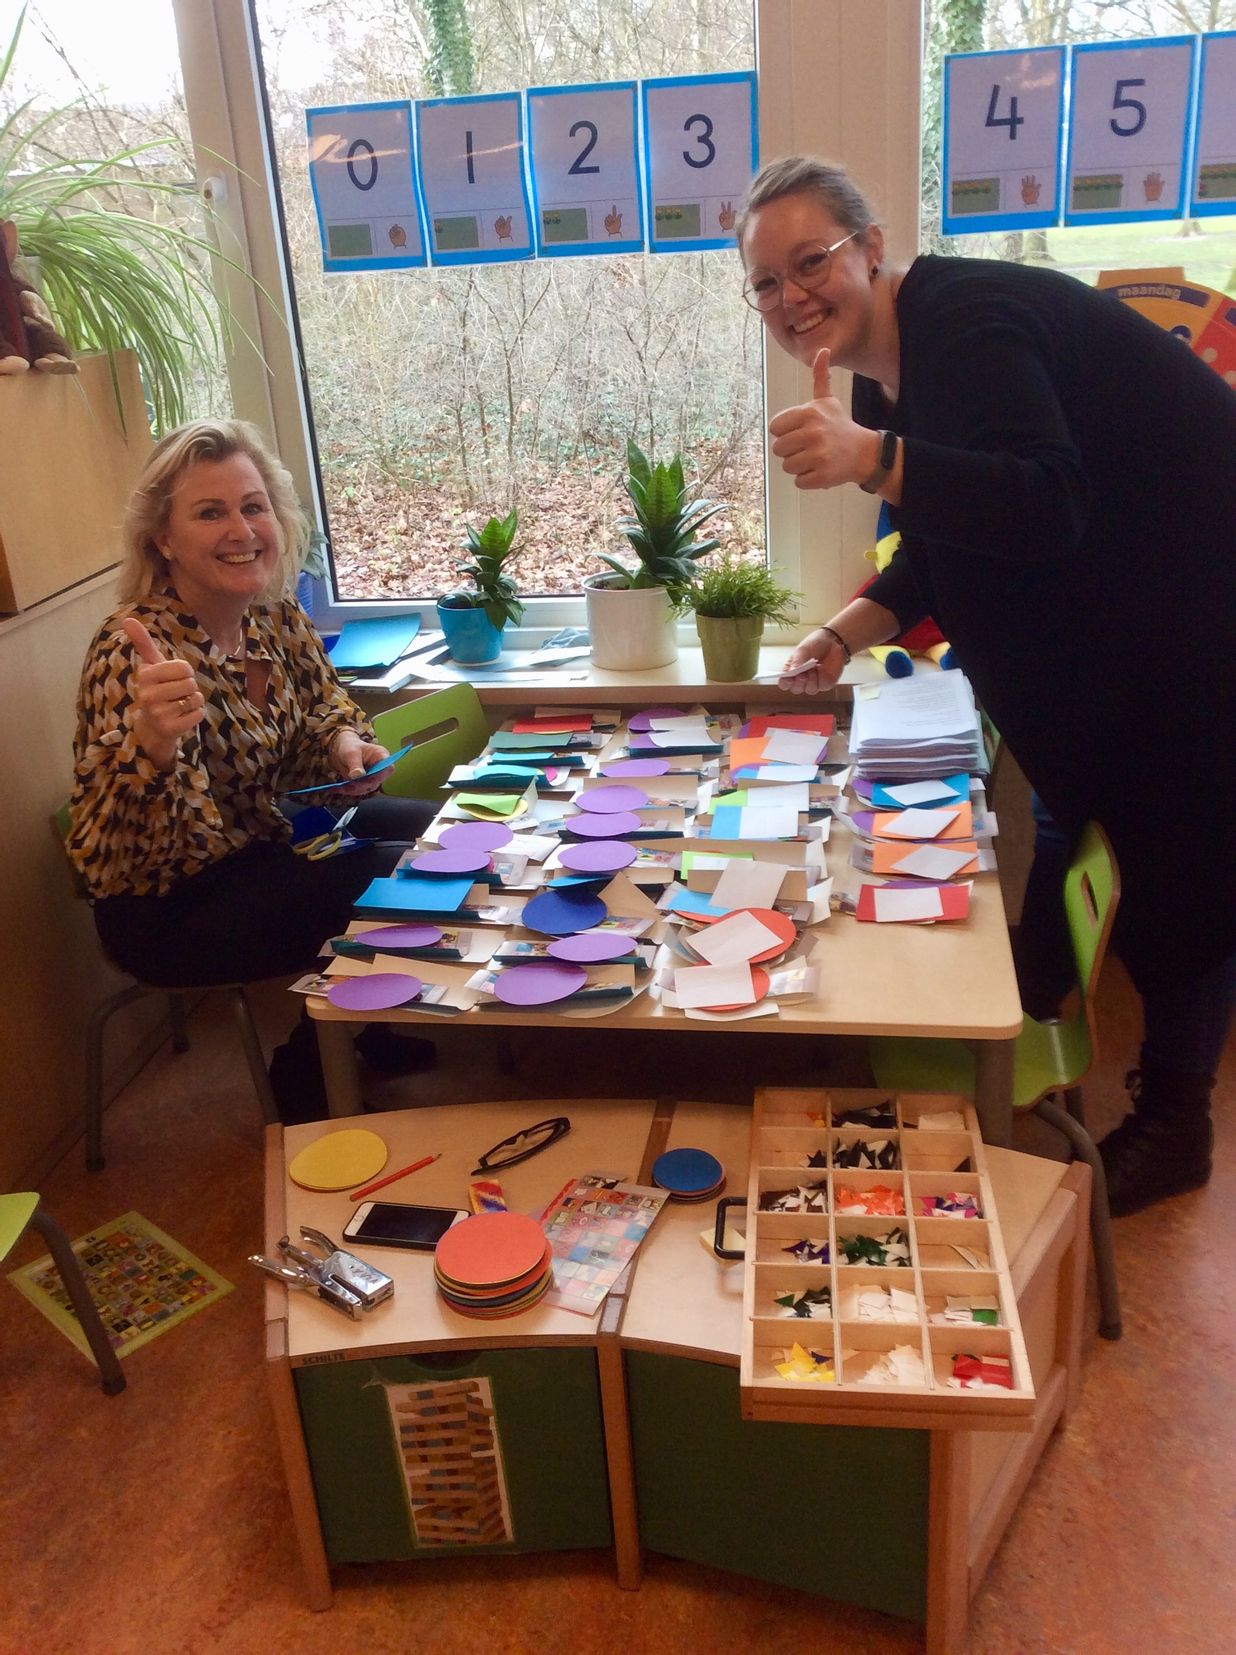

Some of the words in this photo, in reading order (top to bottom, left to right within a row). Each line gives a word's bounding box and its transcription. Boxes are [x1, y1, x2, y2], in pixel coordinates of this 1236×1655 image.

[984, 84, 1025, 141] 4
[1110, 78, 1147, 137] 5
[346, 138, 379, 191] 0
[567, 120, 600, 175] 2
[682, 113, 716, 169] 3
[1117, 284, 1182, 300] maandag
